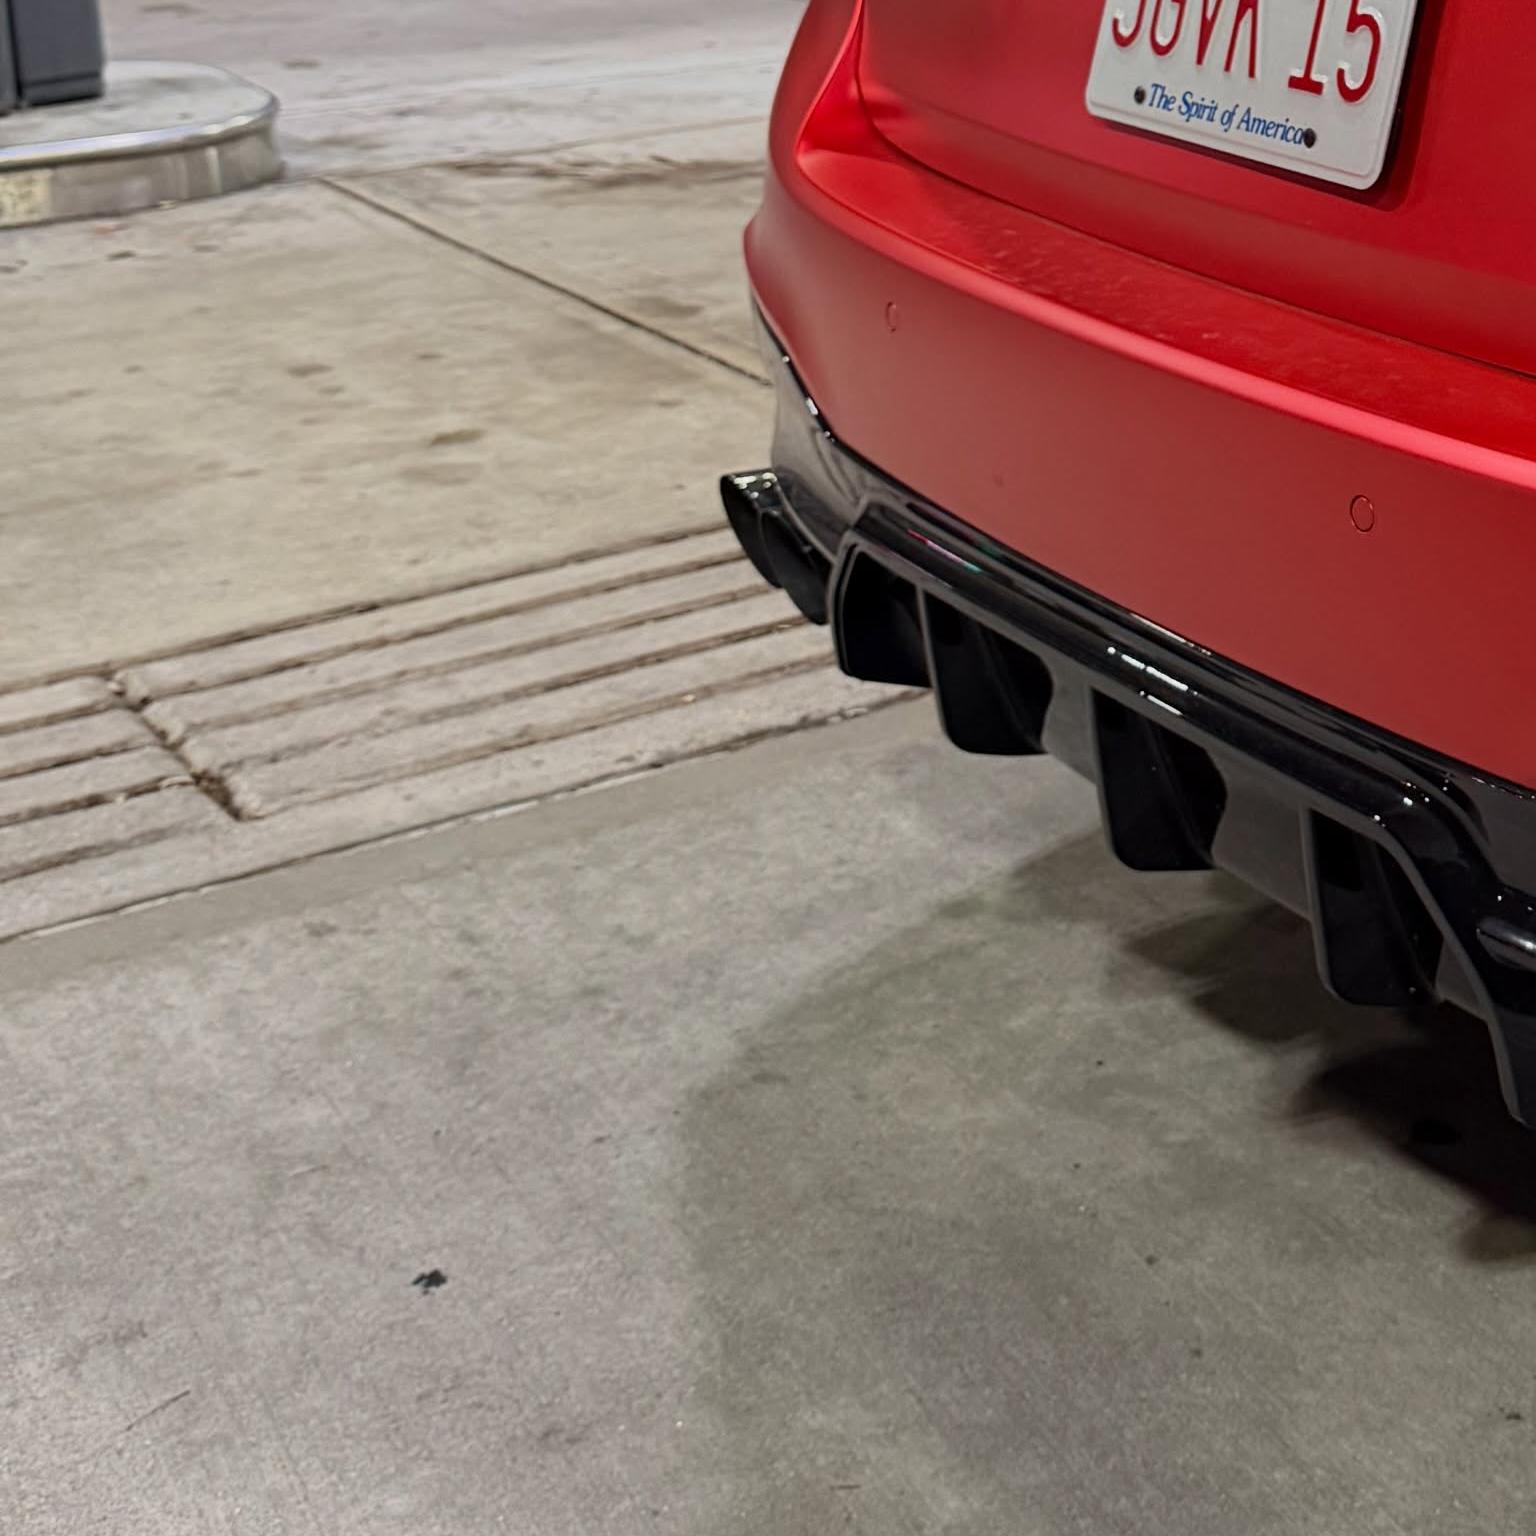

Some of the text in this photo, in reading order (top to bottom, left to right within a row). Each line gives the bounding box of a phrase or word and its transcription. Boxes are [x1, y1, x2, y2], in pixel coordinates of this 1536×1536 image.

[1148, 82, 1306, 145] The Spirit of America
